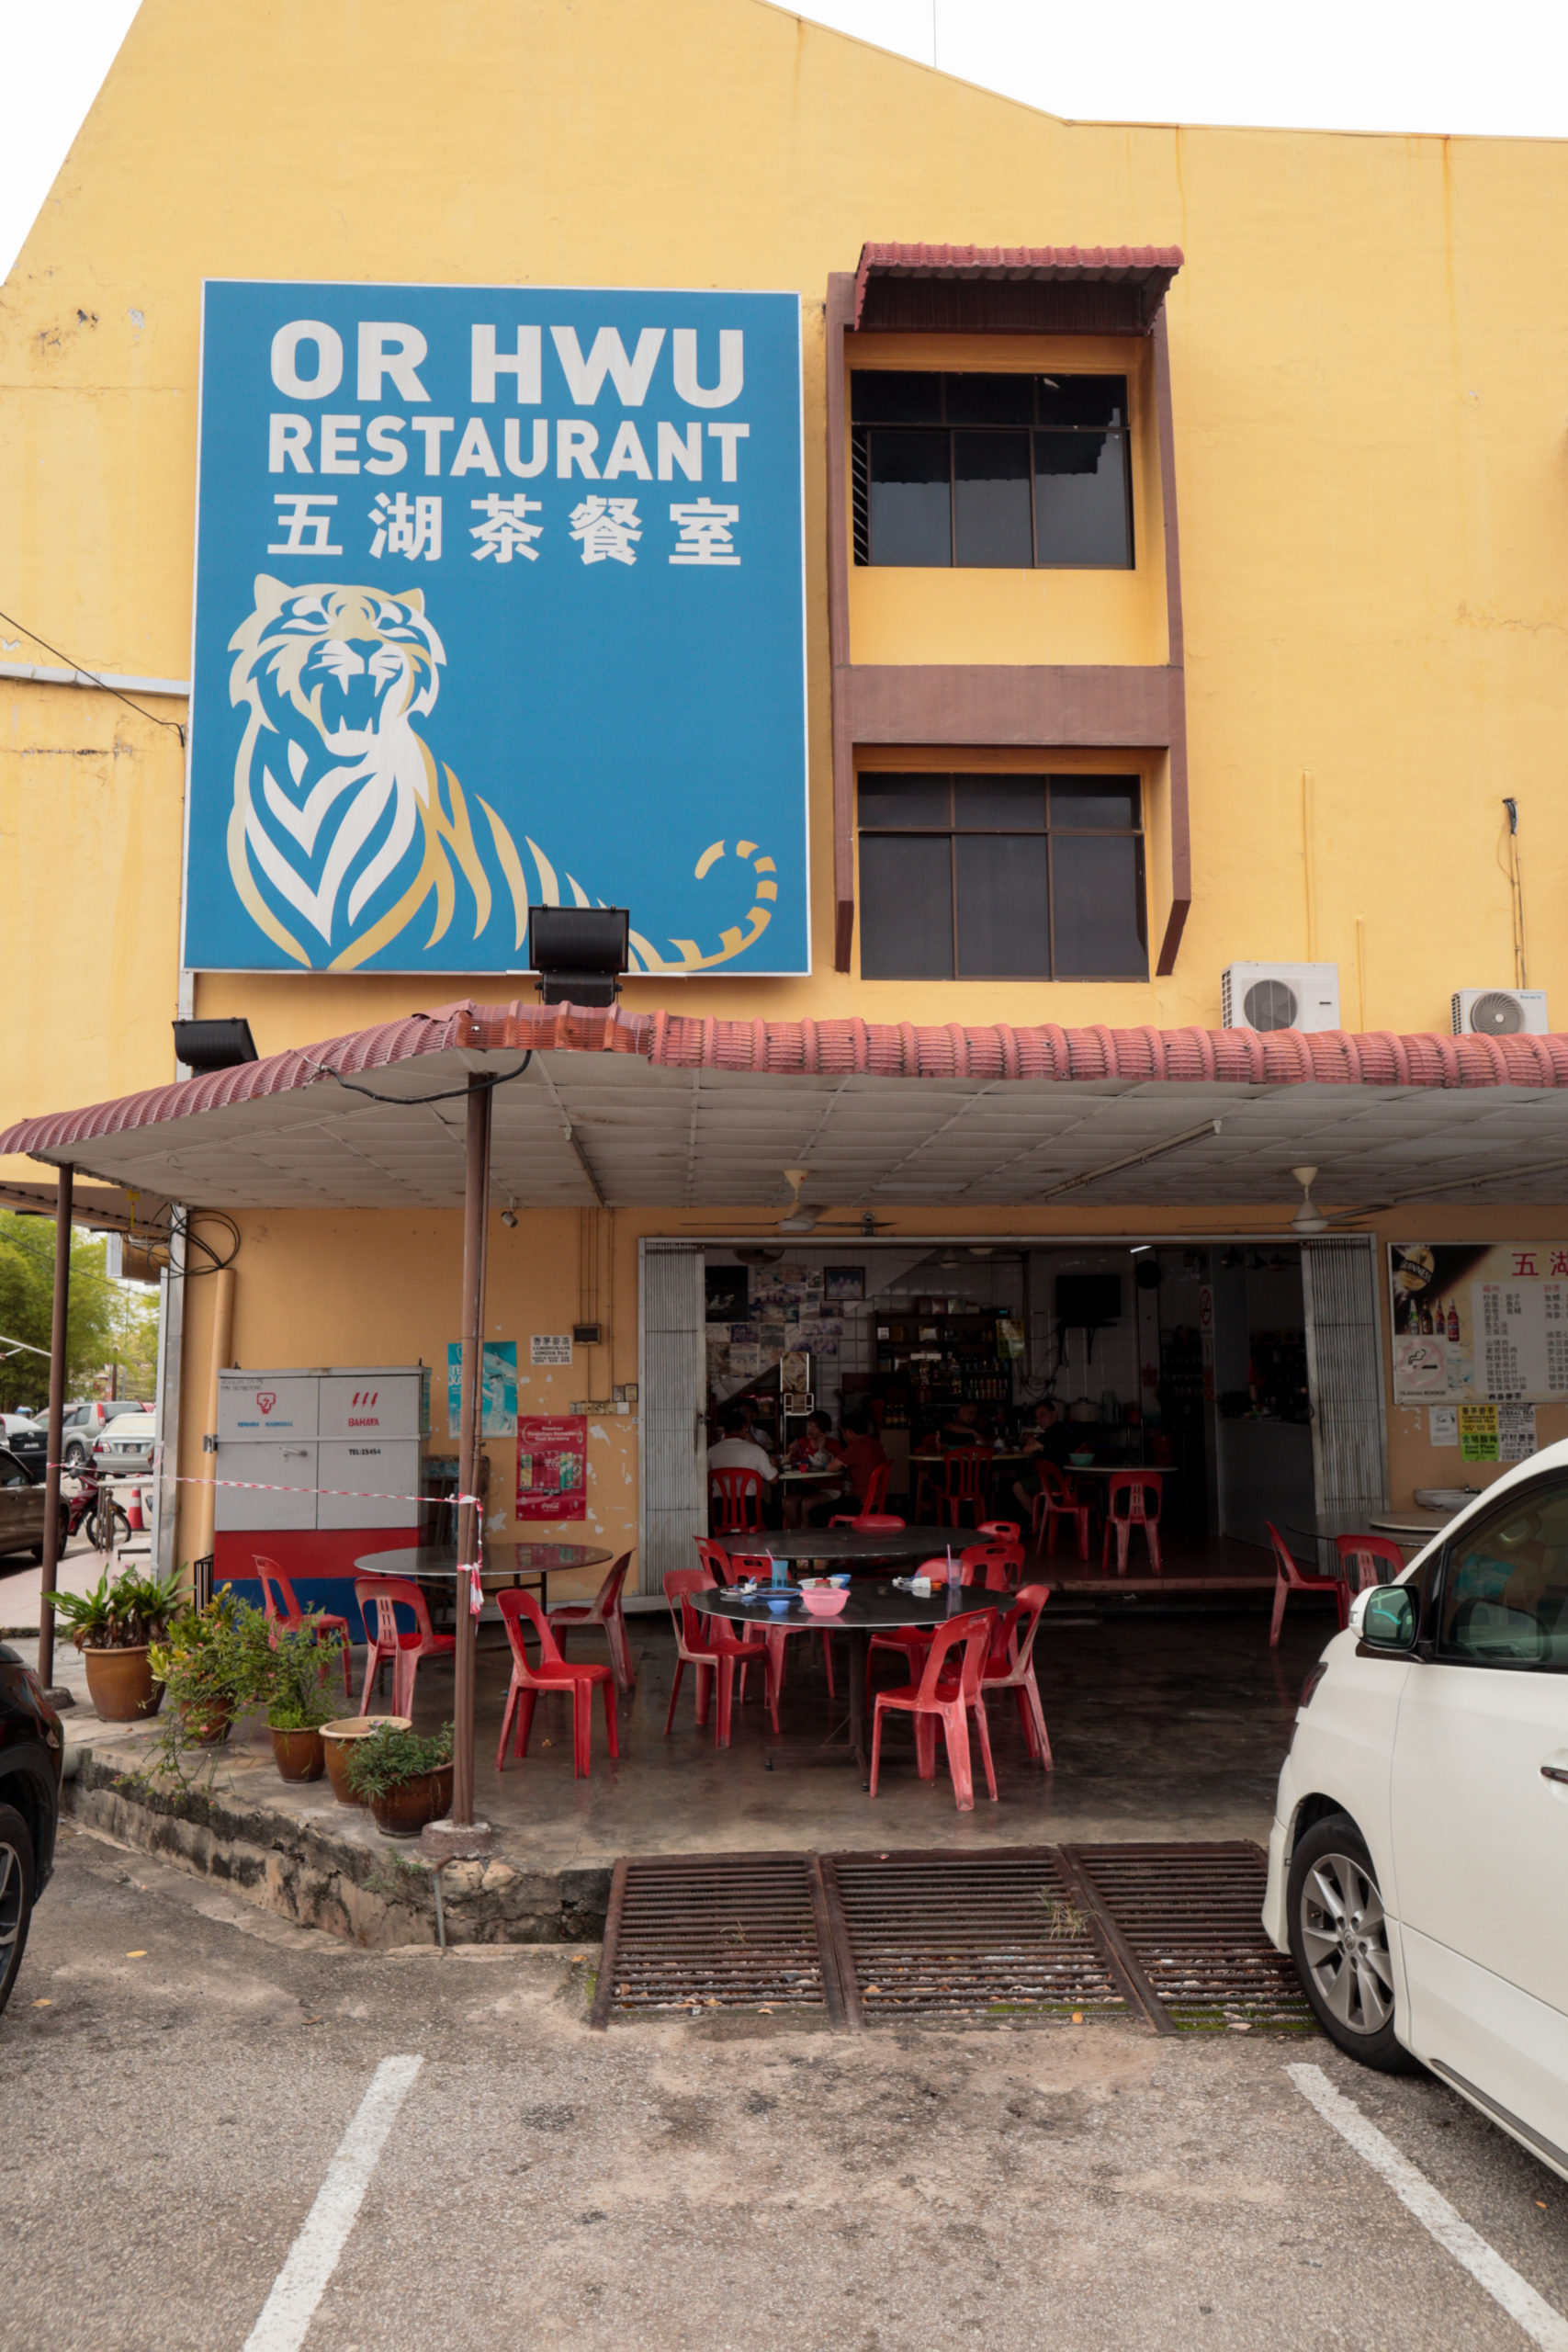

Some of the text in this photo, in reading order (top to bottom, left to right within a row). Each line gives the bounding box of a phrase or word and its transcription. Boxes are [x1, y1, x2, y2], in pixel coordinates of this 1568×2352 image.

[271, 320, 744, 409] OR HWU
[268, 413, 750, 482] RESTAURANT
[267, 492, 741, 566] 五湖茶餐室
[1400, 1260, 1433, 1283] GUINNESS
[348, 1418, 379, 1427] BAHAYA
